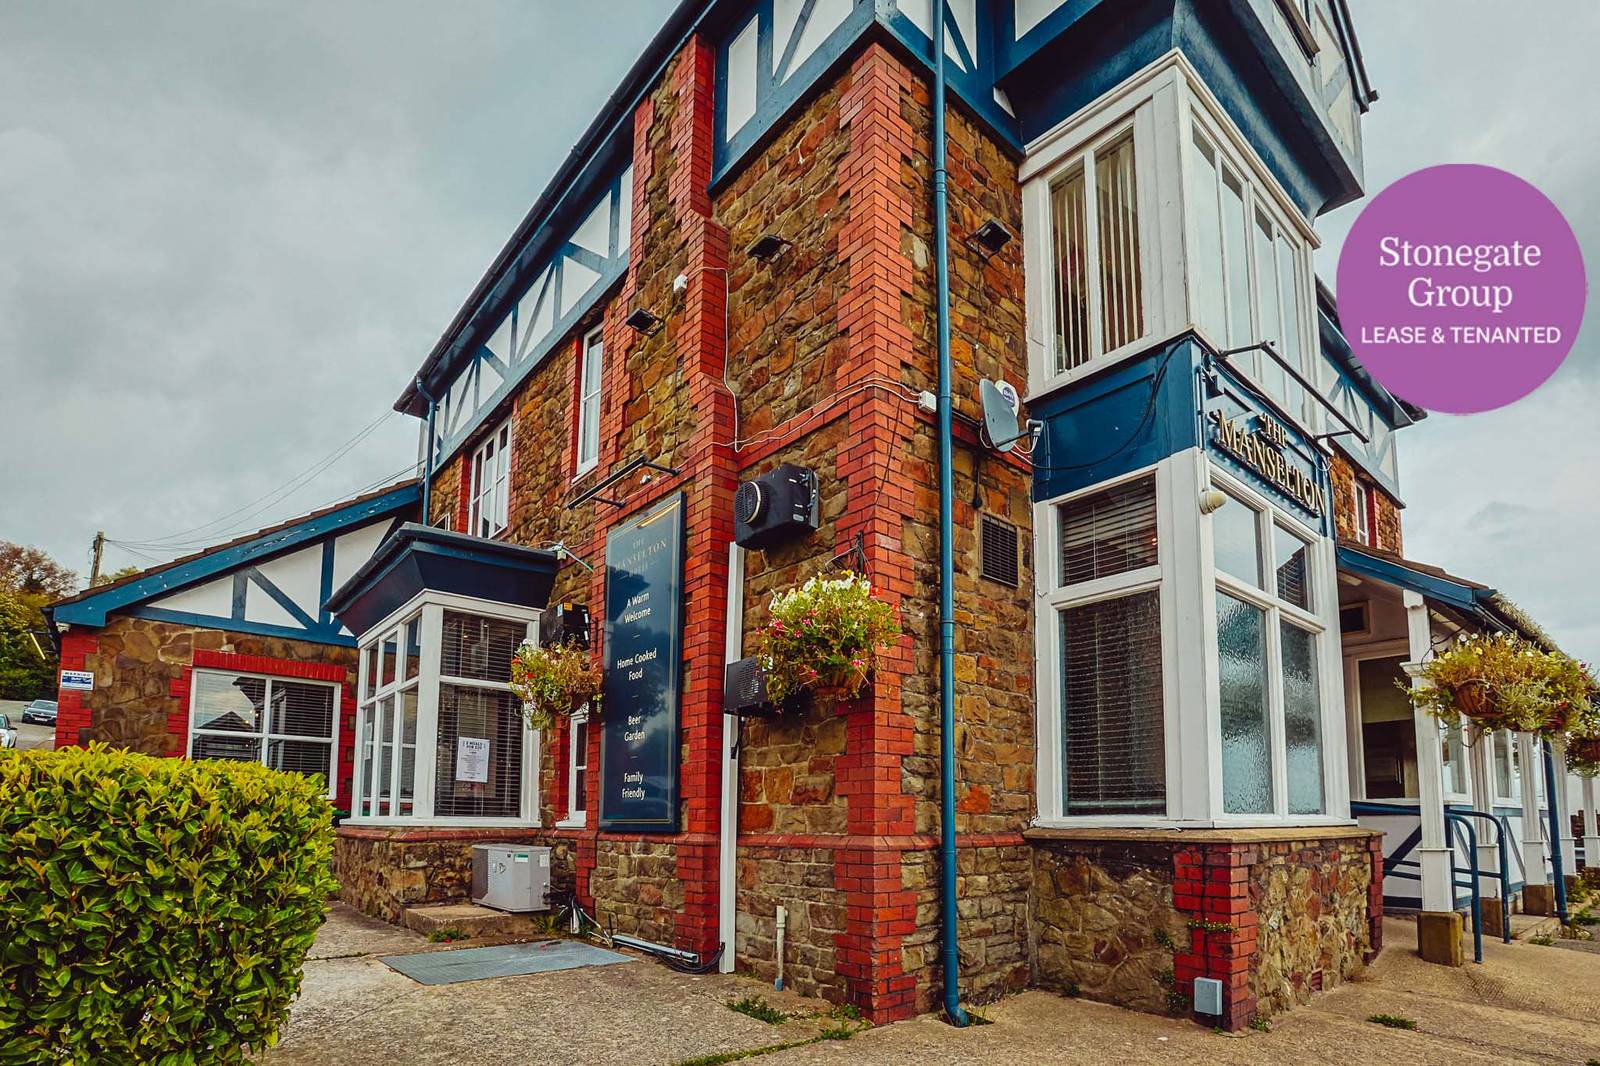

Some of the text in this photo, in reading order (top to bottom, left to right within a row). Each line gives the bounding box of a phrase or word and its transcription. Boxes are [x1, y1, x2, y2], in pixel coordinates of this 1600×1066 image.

[1262, 411, 1288, 449] THE
[1216, 409, 1326, 516] MANSELTON
[626, 592, 650, 608] A Warm
[624, 607, 651, 624] Welcome
[617, 648, 657, 669] Home Cooked
[628, 668, 643, 681] Food
[628, 715, 642, 726] Beer
[624, 729, 646, 742] Garden
[624, 771, 644, 785] Family
[621, 787, 646, 801] Friendly
